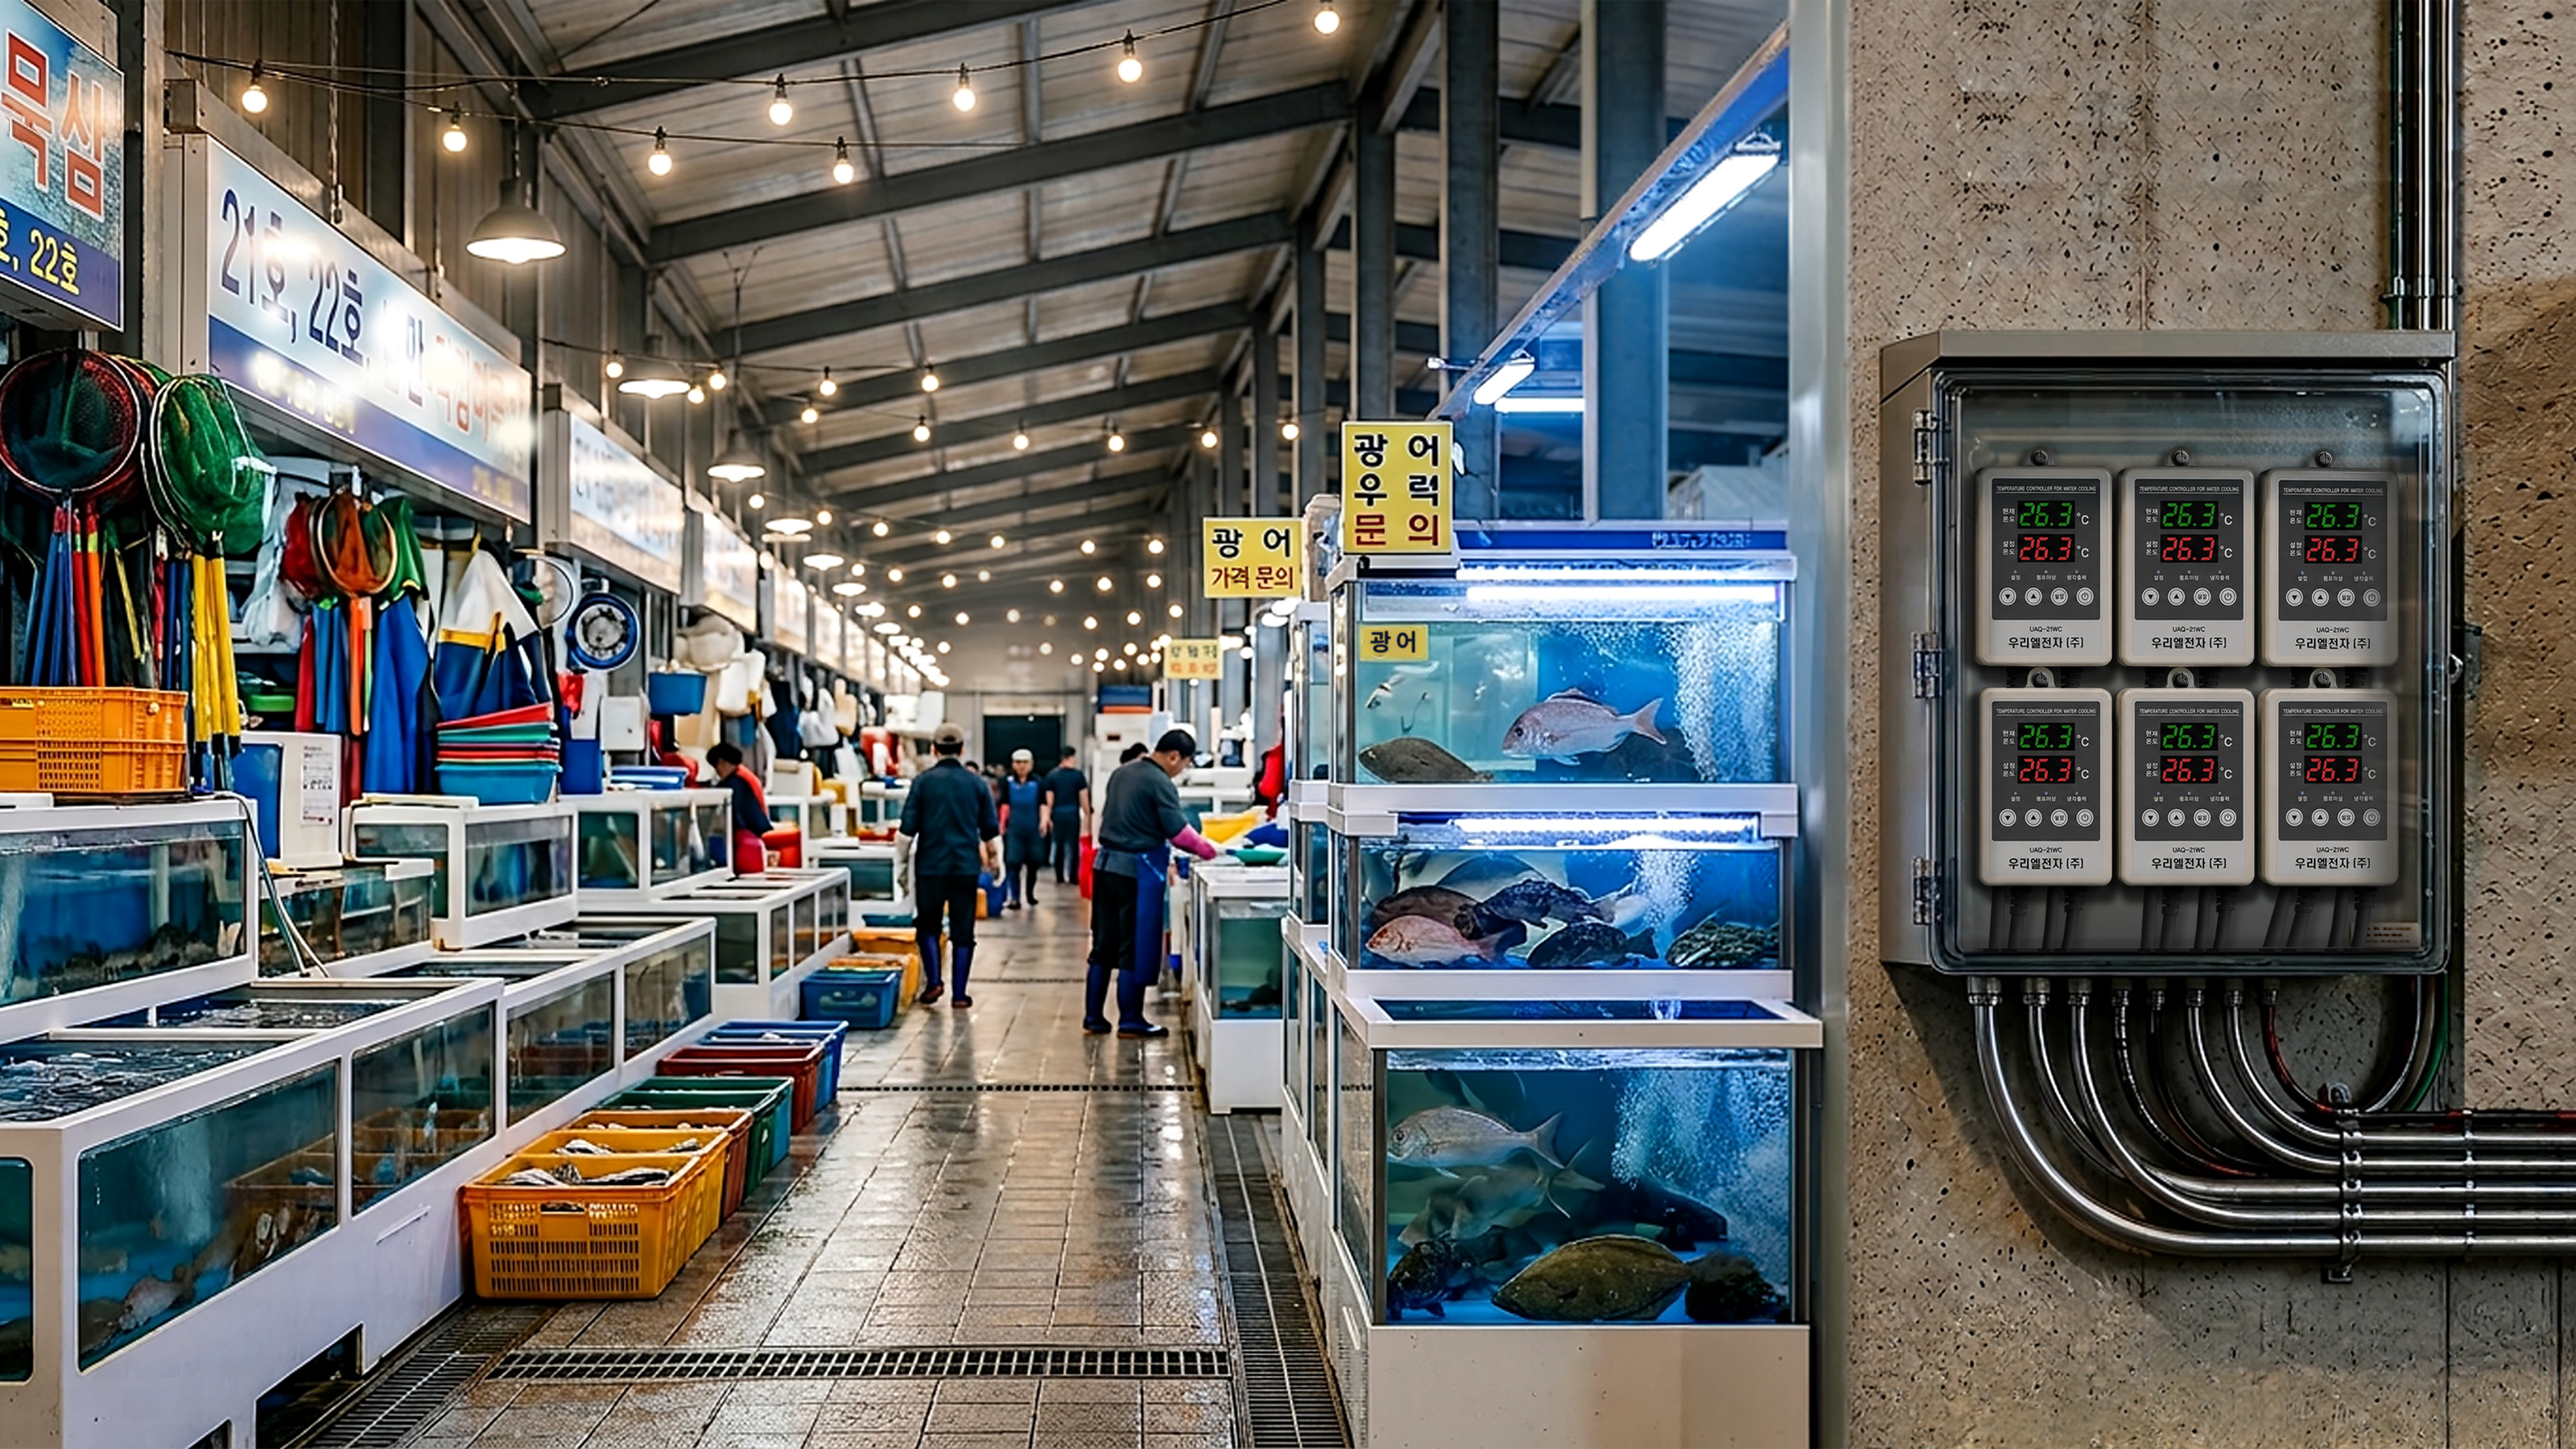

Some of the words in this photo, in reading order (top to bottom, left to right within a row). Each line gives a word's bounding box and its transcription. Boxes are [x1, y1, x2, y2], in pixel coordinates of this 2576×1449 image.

[30, 228, 80, 295] 22호
[2003, 515, 2015, 523] 온도
[2019, 502, 2073, 526] 26.3
[2146, 515, 2158, 523] 온도
[2162, 502, 2216, 526] 26.3
[2290, 517, 2302, 525] 온도
[2306, 504, 2359, 528] 26.3
[2019, 536, 2072, 561] 26.3
[2162, 536, 2215, 561] 26.3
[2306, 537, 2359, 562] 26.3
[1212, 566, 1249, 589] 가격
[1255, 566, 1293, 589] 문의
[2008, 637, 2063, 649] 우리엘전자
[2066, 637, 2084, 649] (주)
[2151, 637, 2207, 649] 우리엘전자
[2209, 637, 2227, 649] (주)
[2294, 638, 2350, 650] 우리엘전자
[2352, 638, 2371, 650] (주)
[2003, 737, 2015, 745] 온도
[2019, 724, 2073, 749] 26.3
[2146, 737, 2158, 745] 온도
[2161, 724, 2215, 749] 26.3
[2289, 737, 2301, 745] 온도
[2306, 724, 2359, 749] 26.3
[2019, 758, 2072, 782] 26.3
[2161, 758, 2215, 782] 26.3
[2306, 758, 2359, 782] 26.3
[2008, 857, 2063, 869] 우리엘전자
[2066, 858, 2084, 870] (주)
[2151, 857, 2207, 869] 우리엘전자
[2209, 857, 2227, 869] (주)
[2294, 857, 2350, 869] 우리엘전자
[2352, 857, 2371, 869] (주)
